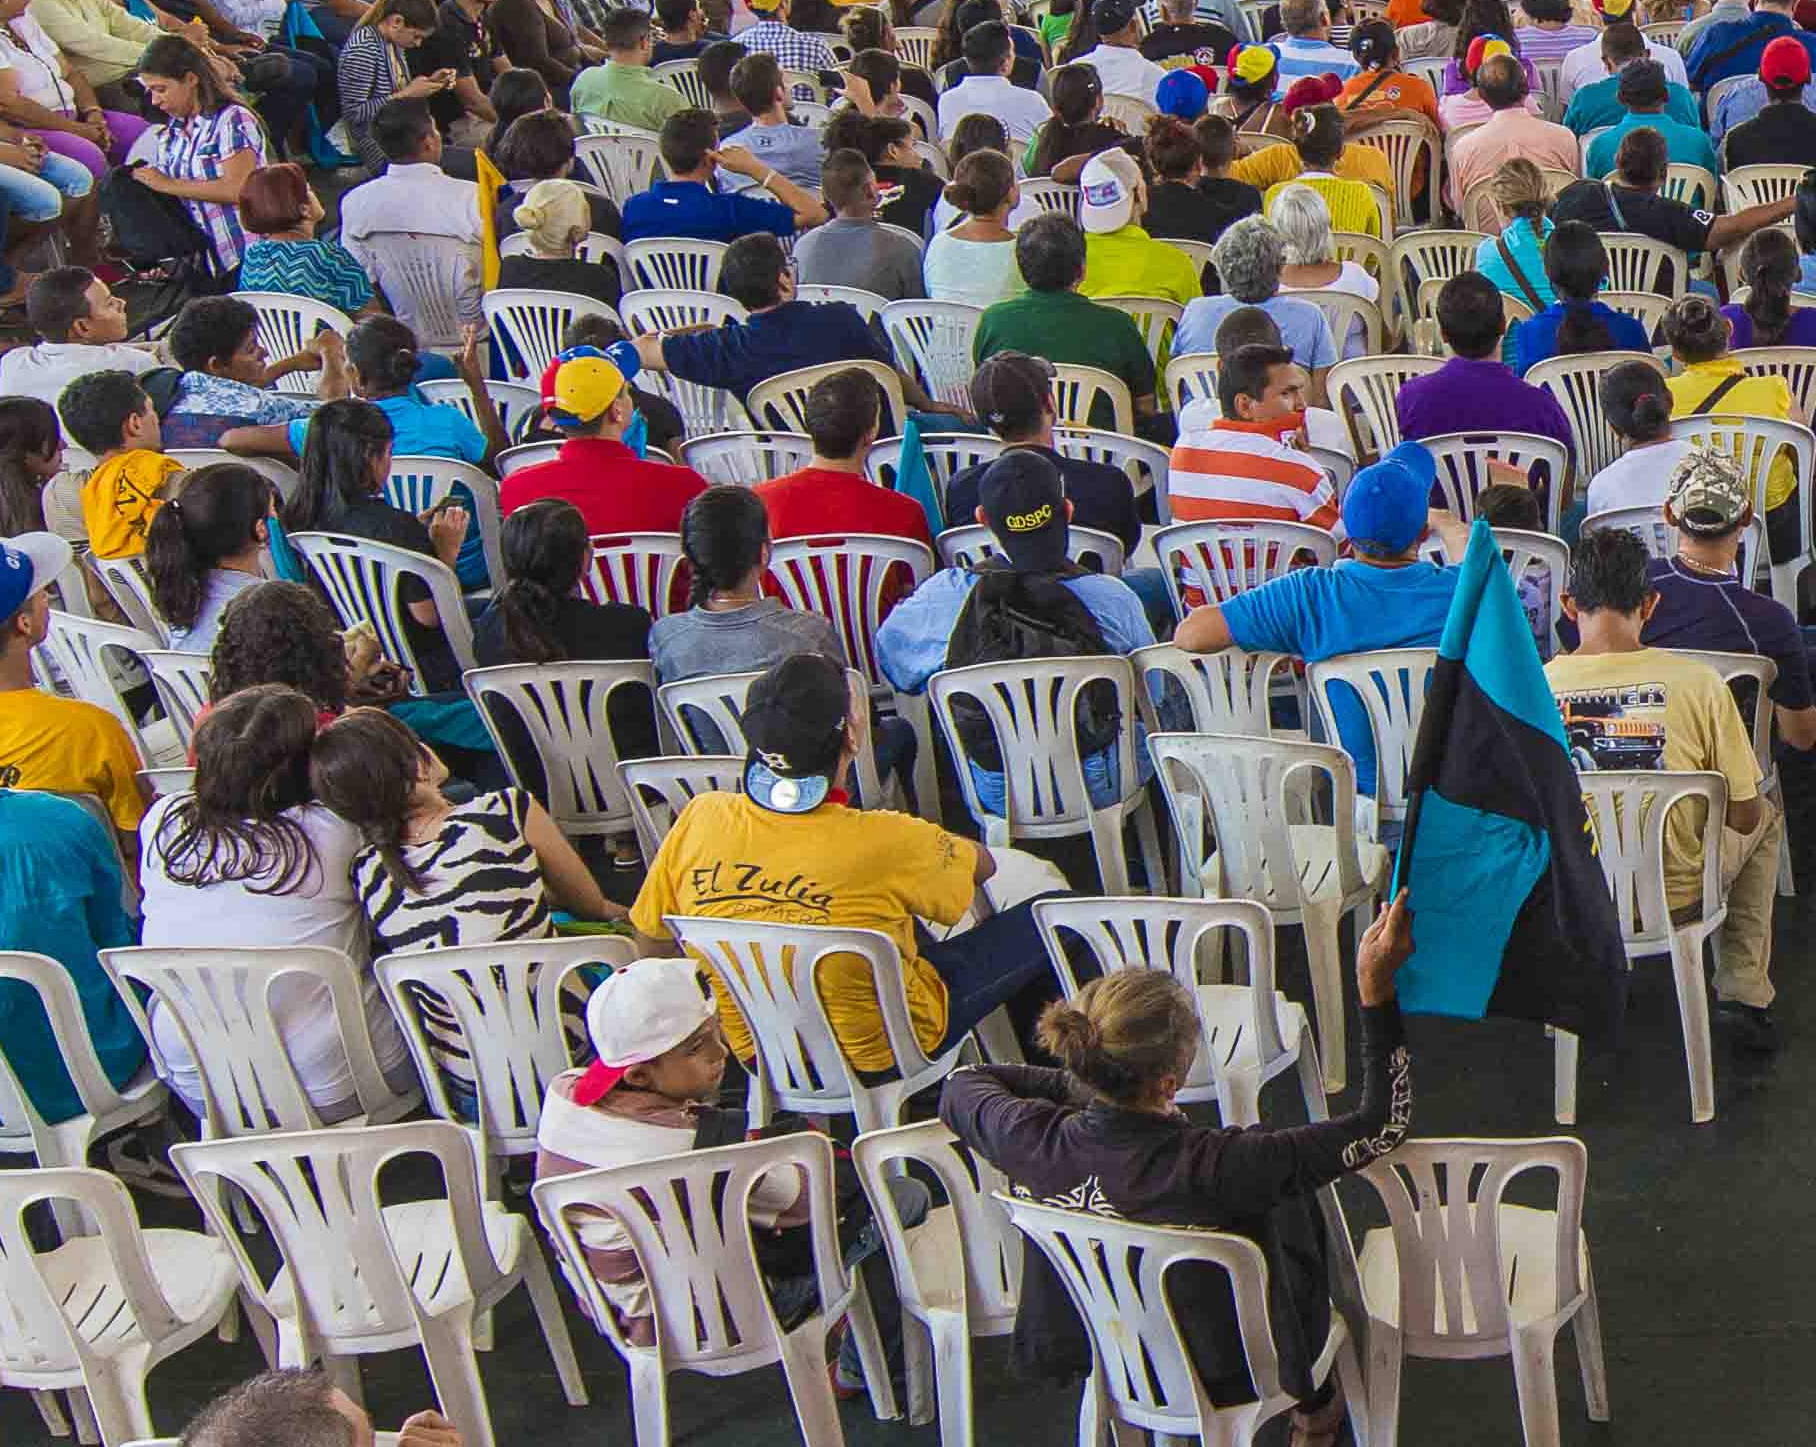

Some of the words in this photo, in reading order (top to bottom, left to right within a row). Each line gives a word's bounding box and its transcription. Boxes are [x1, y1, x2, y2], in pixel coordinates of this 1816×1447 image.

[1006, 504, 1052, 529] GDSPC
[692, 860, 721, 896] El
[734, 863, 833, 906] Zulia
